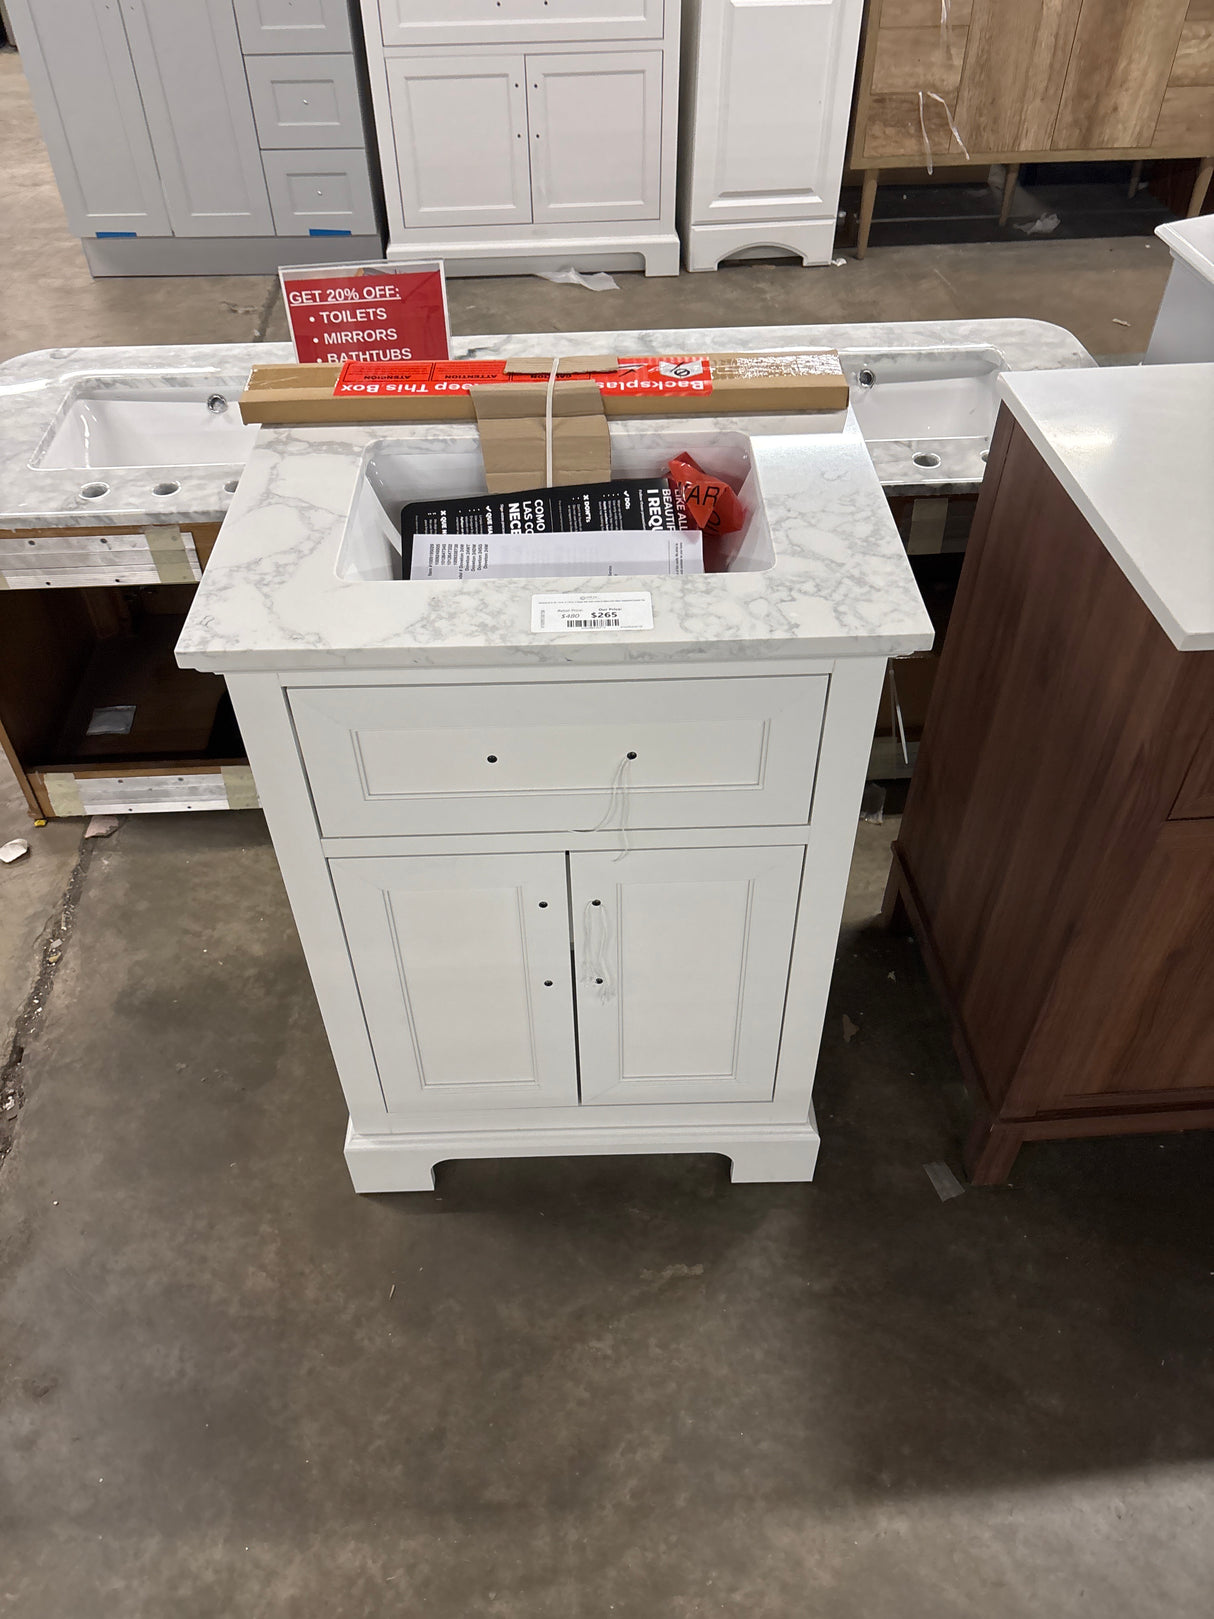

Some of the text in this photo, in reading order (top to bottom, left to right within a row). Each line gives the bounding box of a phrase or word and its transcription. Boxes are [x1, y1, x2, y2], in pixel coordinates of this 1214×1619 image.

[289, 285, 400, 304] GET 20% OFF:
[319, 307, 388, 324] TOILETS
[323, 328, 398, 345] MIRRORS
[327, 347, 412, 363] BATHTUBS
[340, 383, 380, 393] Box
[385, 383, 429, 393] This
[674, 489, 686, 511] LIKE
[485, 512, 493, 525] QUE
[522, 501, 533, 520] LAS
[534, 499, 546, 531] COMO
[440, 516, 448, 528] QUE
[677, 512, 688, 531] ALL
